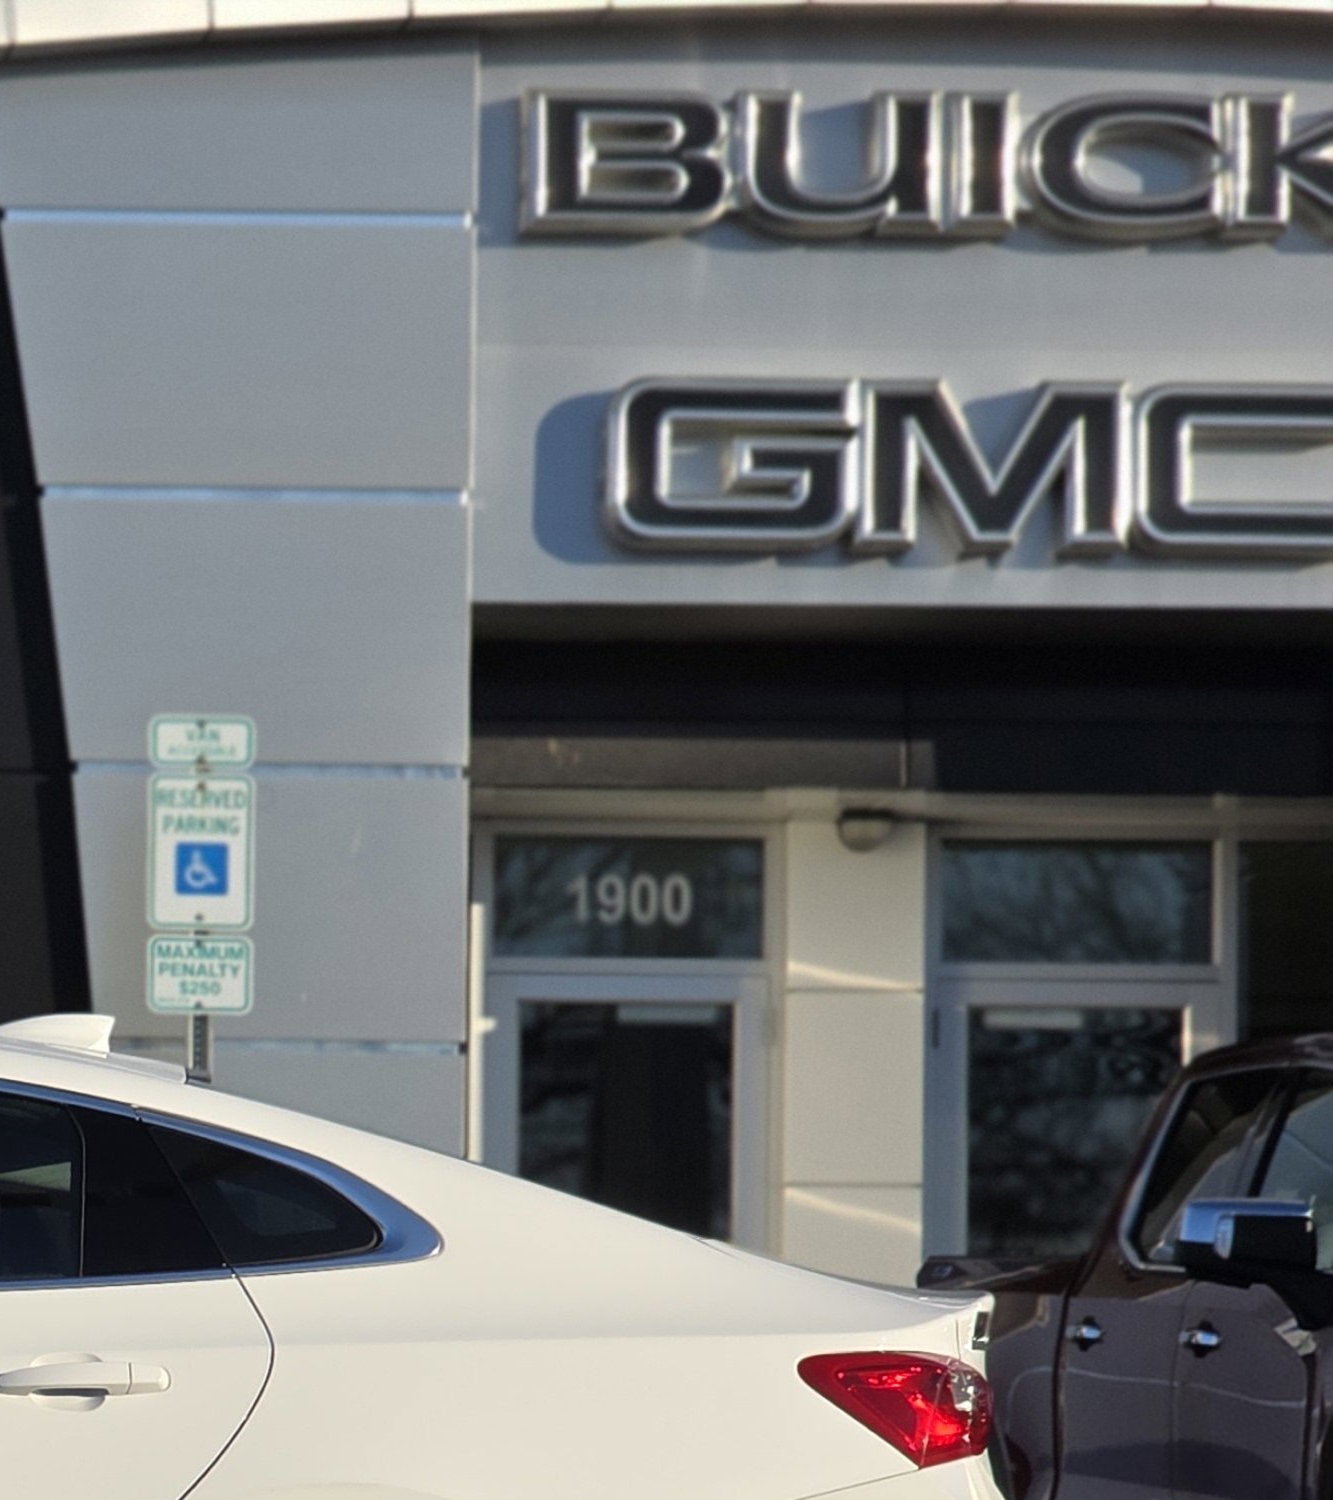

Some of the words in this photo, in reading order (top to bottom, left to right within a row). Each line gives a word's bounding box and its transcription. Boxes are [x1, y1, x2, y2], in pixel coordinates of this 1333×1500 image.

[519, 89, 1333, 242] BUICK
[606, 376, 1333, 556] GMC
[154, 789, 246, 809] RESERVED
[162, 814, 240, 835] PARKING
[565, 872, 693, 926] 1900
[157, 945, 245, 959] MAXIMUM
[159, 962, 241, 977] PENALTY
[179, 981, 222, 995] $250
